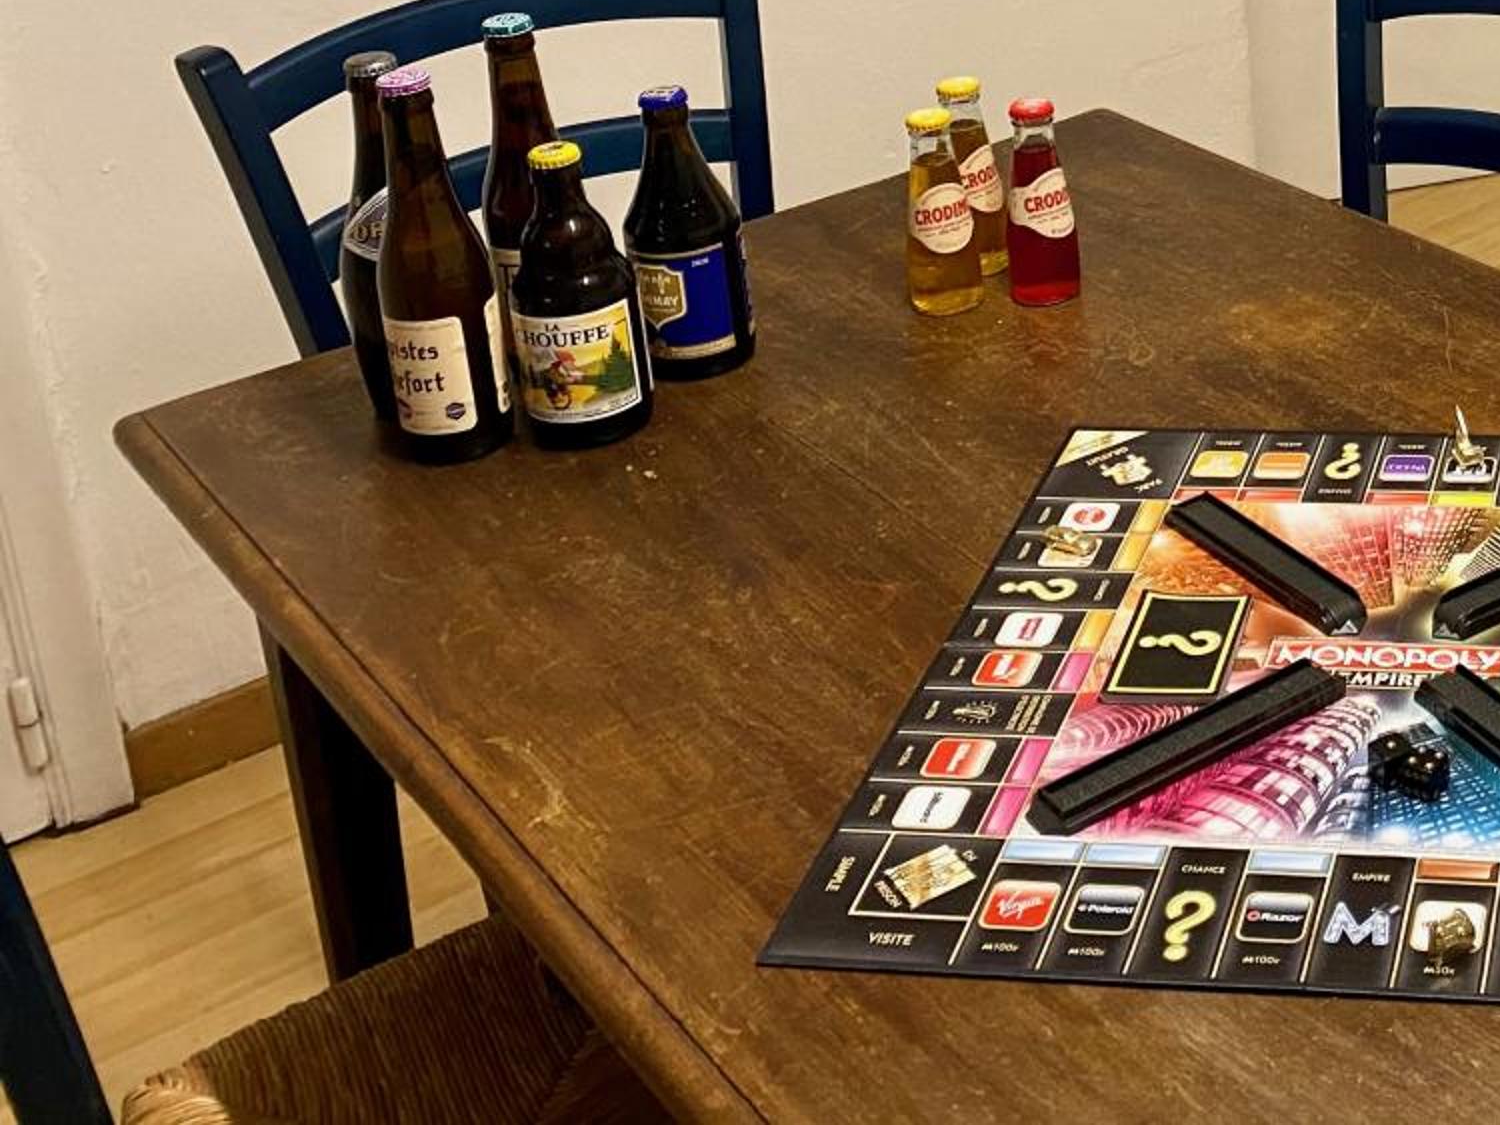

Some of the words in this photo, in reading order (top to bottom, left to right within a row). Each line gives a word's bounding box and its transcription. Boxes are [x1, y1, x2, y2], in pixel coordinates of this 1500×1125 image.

[997, 891, 1044, 919] Virgin
[1086, 904, 1134, 915] Polaroid
[868, 932, 914, 946] VISITE
